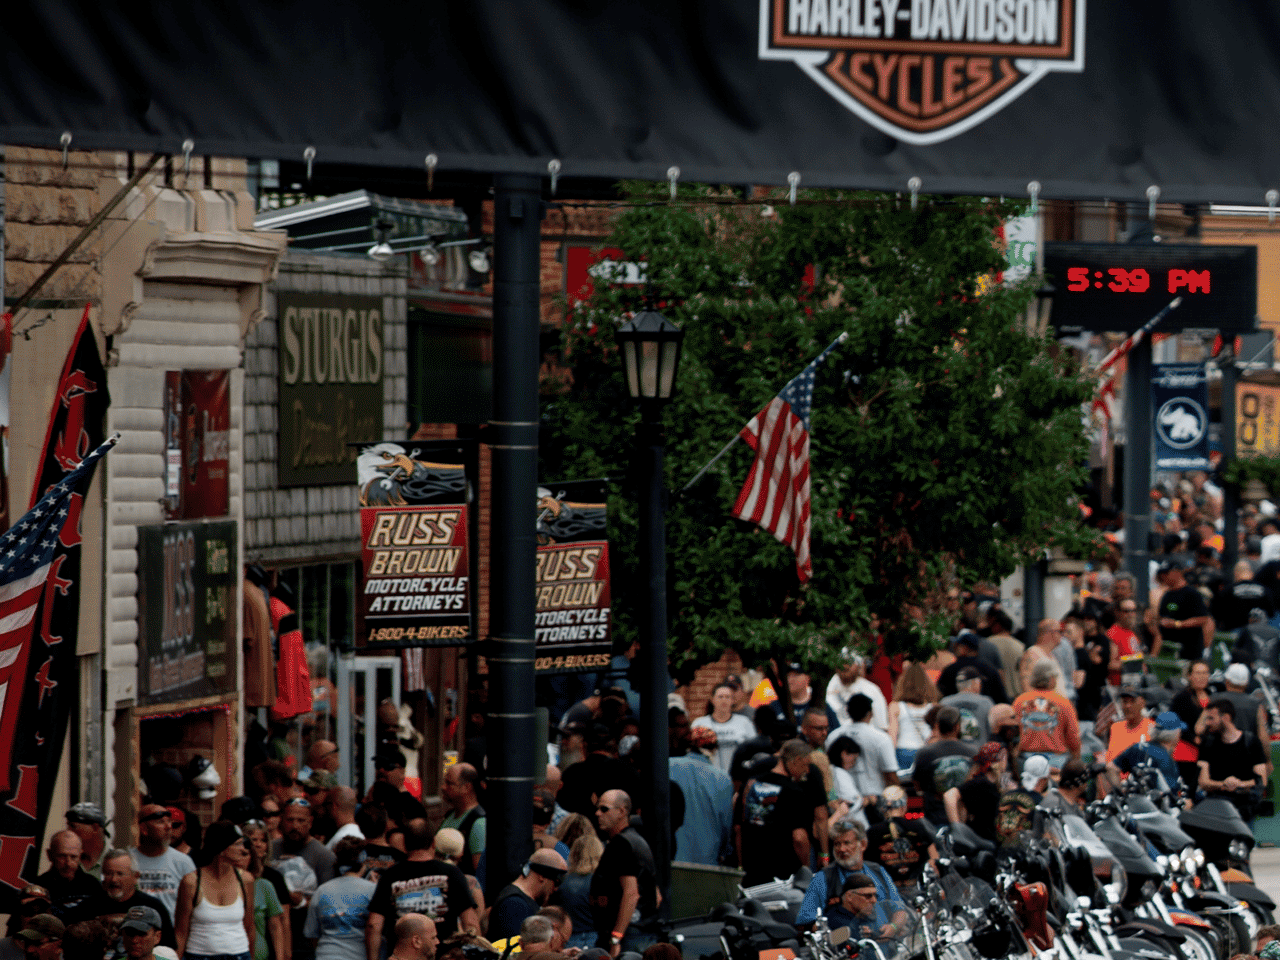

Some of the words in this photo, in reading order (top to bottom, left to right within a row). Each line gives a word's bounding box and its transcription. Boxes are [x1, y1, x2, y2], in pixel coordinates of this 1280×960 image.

[788, 0, 1058, 44] HARLEY-DAVIDSON
[850, 53, 994, 116] CYCLES
[1067, 267, 1150, 293] 5:39
[1167, 269, 1211, 294] PM
[283, 306, 382, 385] STURGIS
[370, 511, 459, 547] RUSS
[369, 549, 461, 576] BROWN
[364, 577, 468, 594] MOTORCYCLE
[369, 595, 465, 612] ATTORNEYS
[369, 625, 468, 641] 1-800-4-BIKERS
